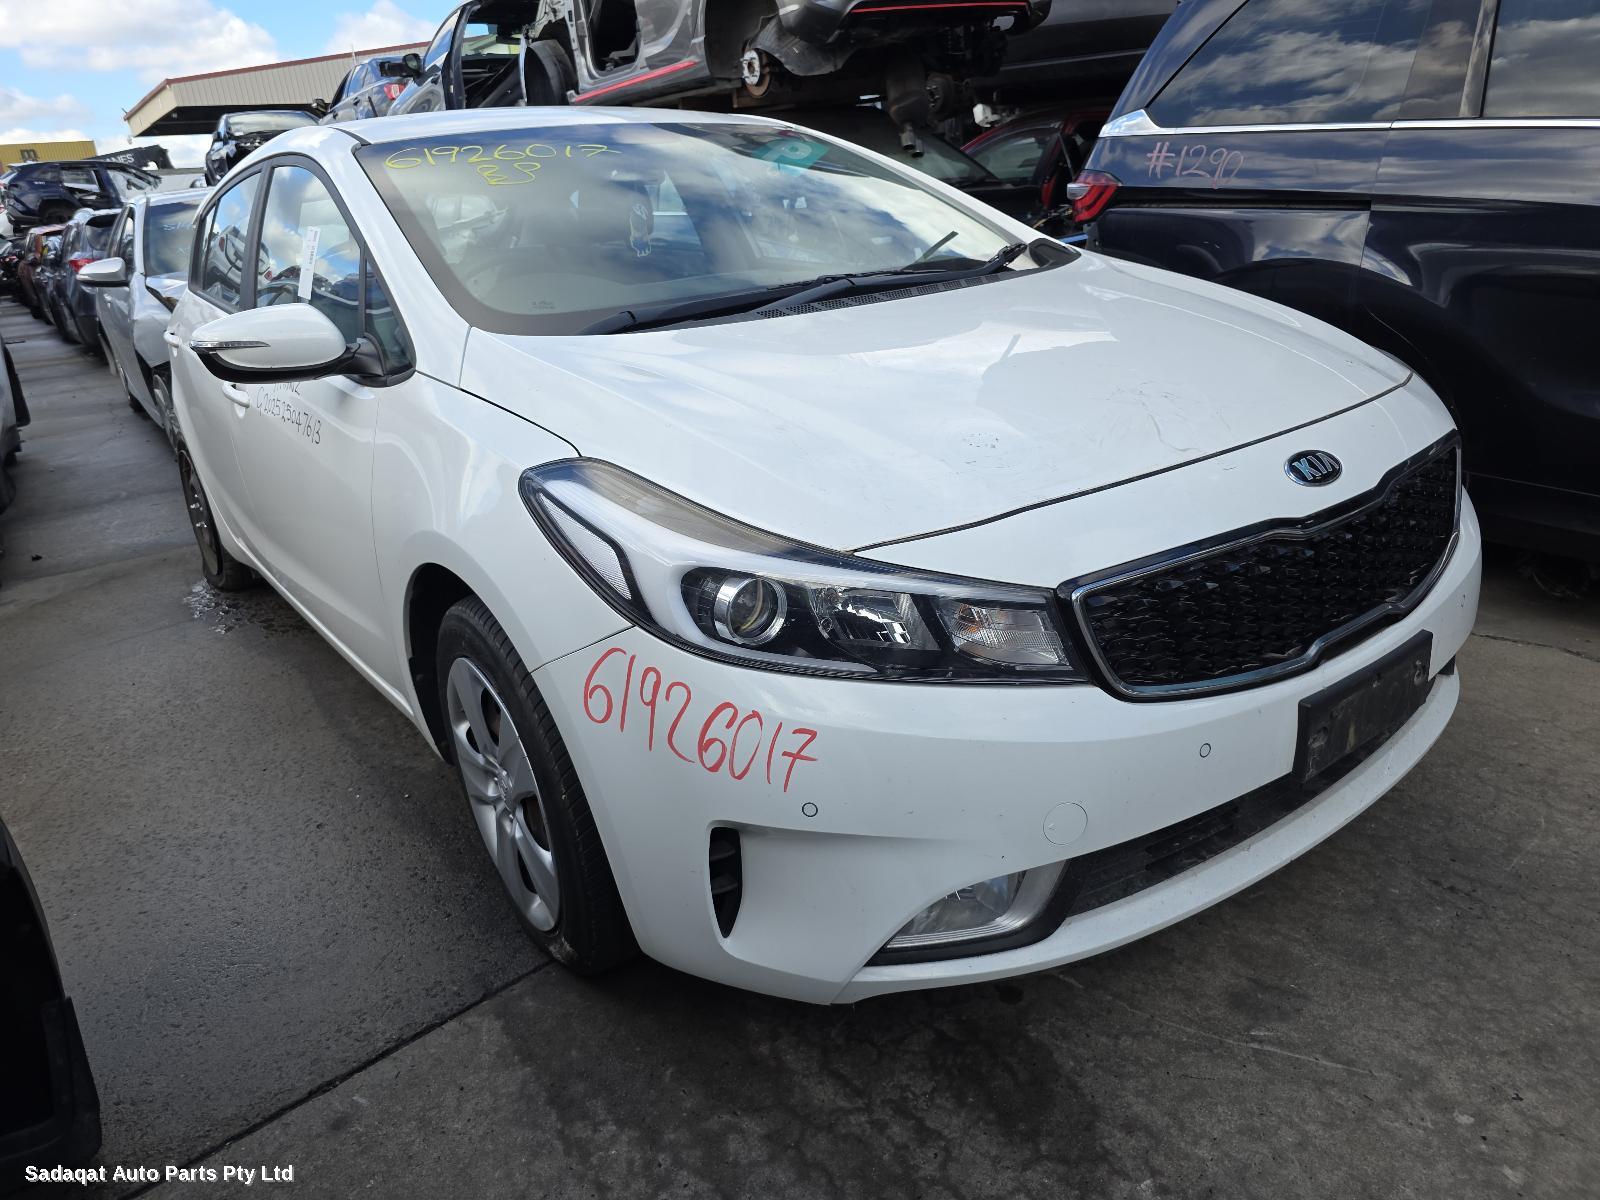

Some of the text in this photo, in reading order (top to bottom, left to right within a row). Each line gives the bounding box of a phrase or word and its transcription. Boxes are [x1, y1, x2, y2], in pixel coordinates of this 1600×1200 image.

[384, 143, 623, 169] 61926017
[1291, 452, 1340, 481] KIA
[583, 647, 819, 793] 61926017
